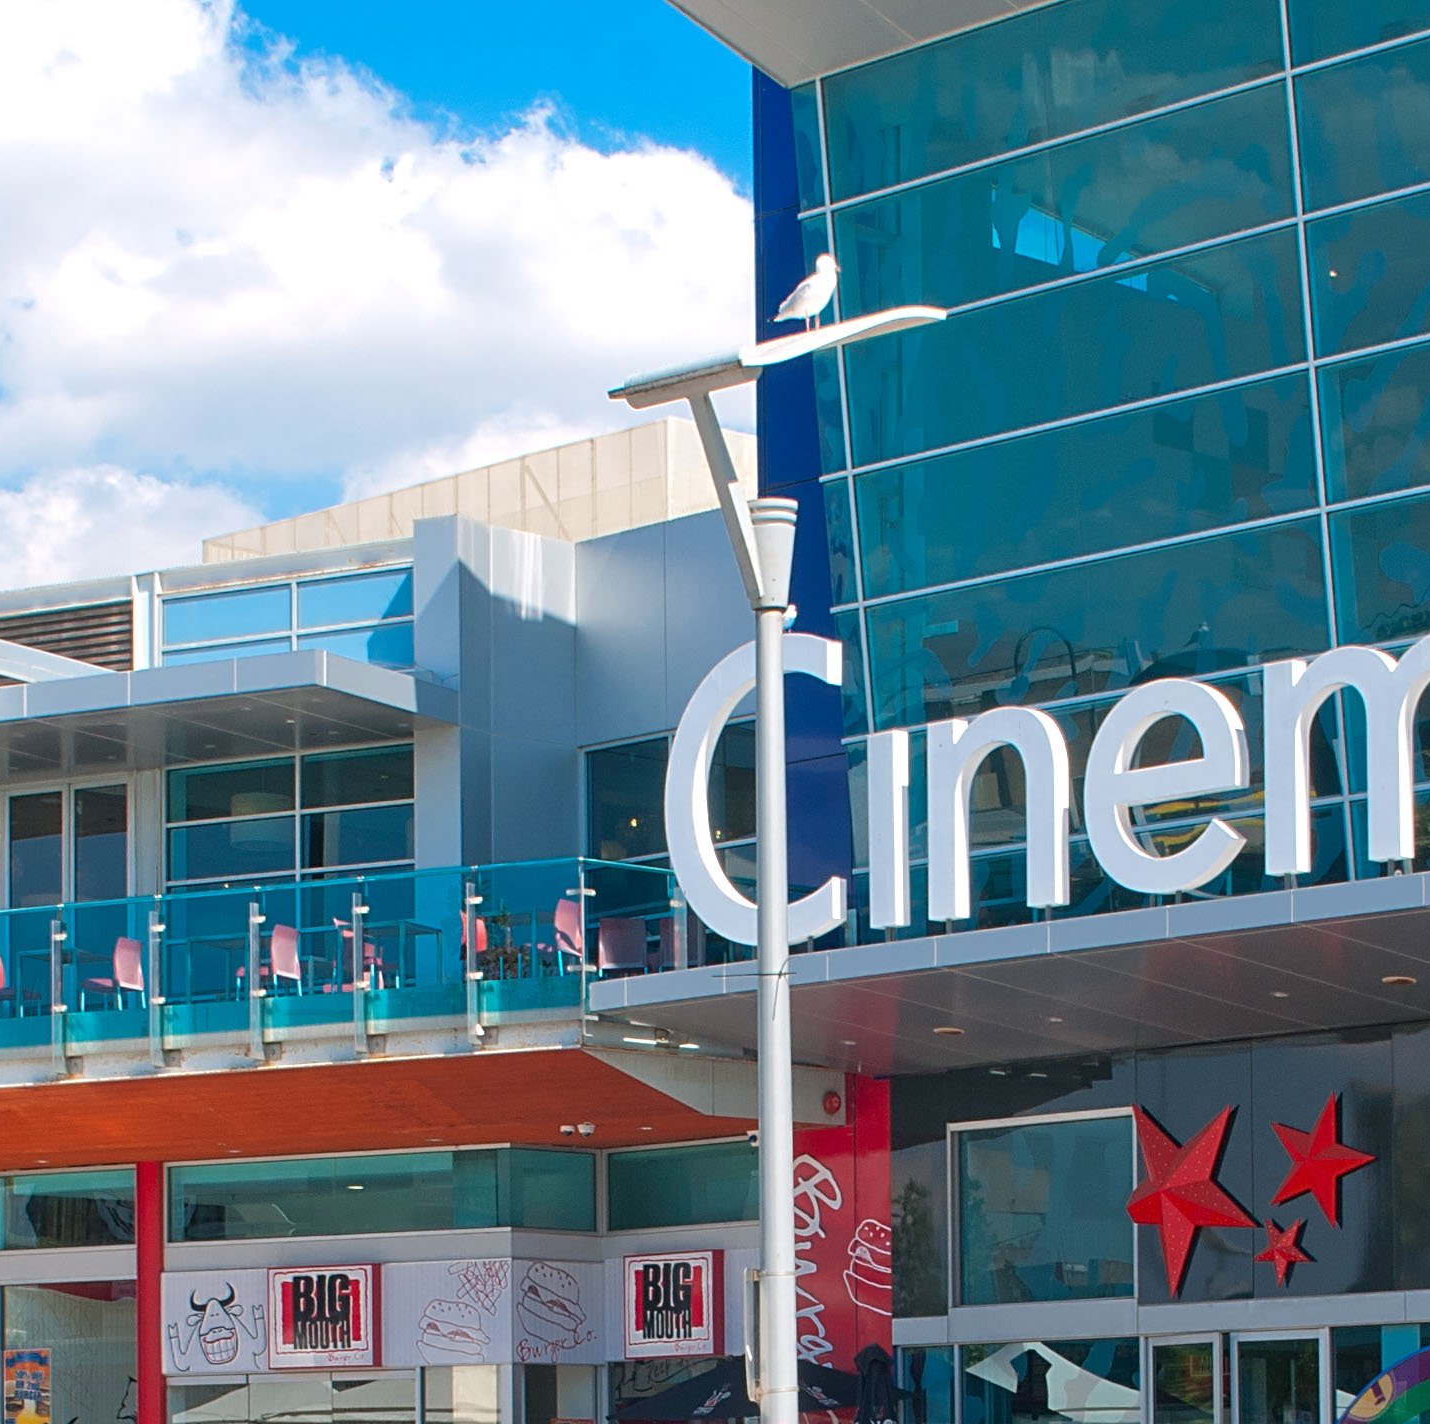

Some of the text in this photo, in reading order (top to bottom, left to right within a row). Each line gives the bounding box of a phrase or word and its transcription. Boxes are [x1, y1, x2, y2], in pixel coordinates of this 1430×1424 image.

[293, 1273, 352, 1321] BIG
[643, 1262, 692, 1313] BIG
[293, 1320, 352, 1350] MOUTH
[643, 1309, 692, 1339] MOUTH
[516, 1337, 575, 1364] Burger
